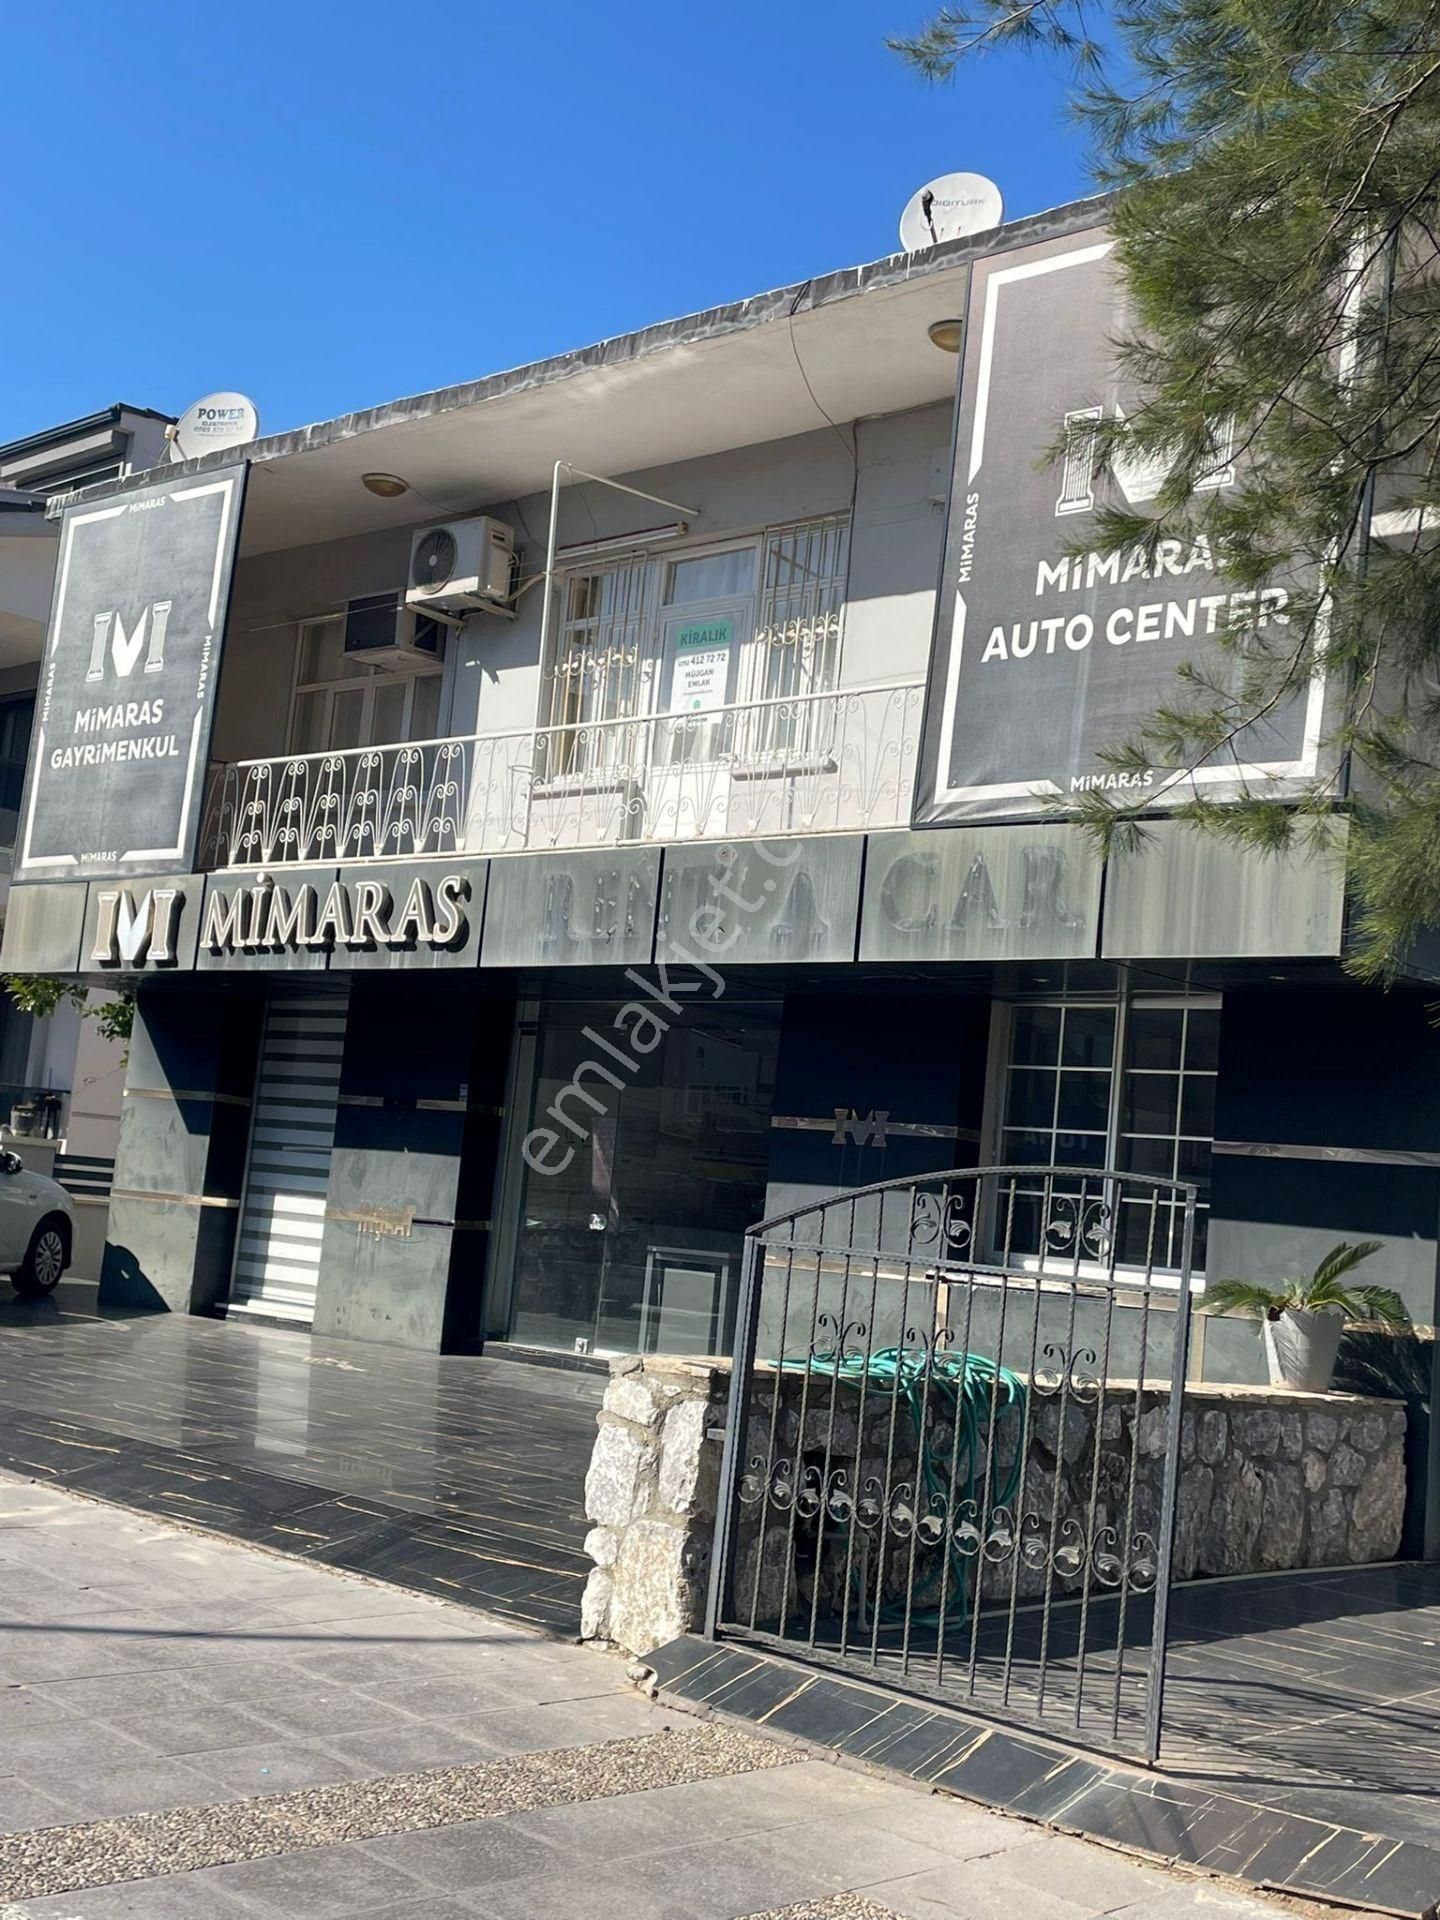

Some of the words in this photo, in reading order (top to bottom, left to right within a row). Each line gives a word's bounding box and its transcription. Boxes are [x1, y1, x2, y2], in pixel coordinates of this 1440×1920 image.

[197, 408, 244, 420] POWER
[981, 614, 1095, 663] AUTO
[1106, 587, 1291, 646] CENTER
[680, 627, 728, 646] KİRALIK
